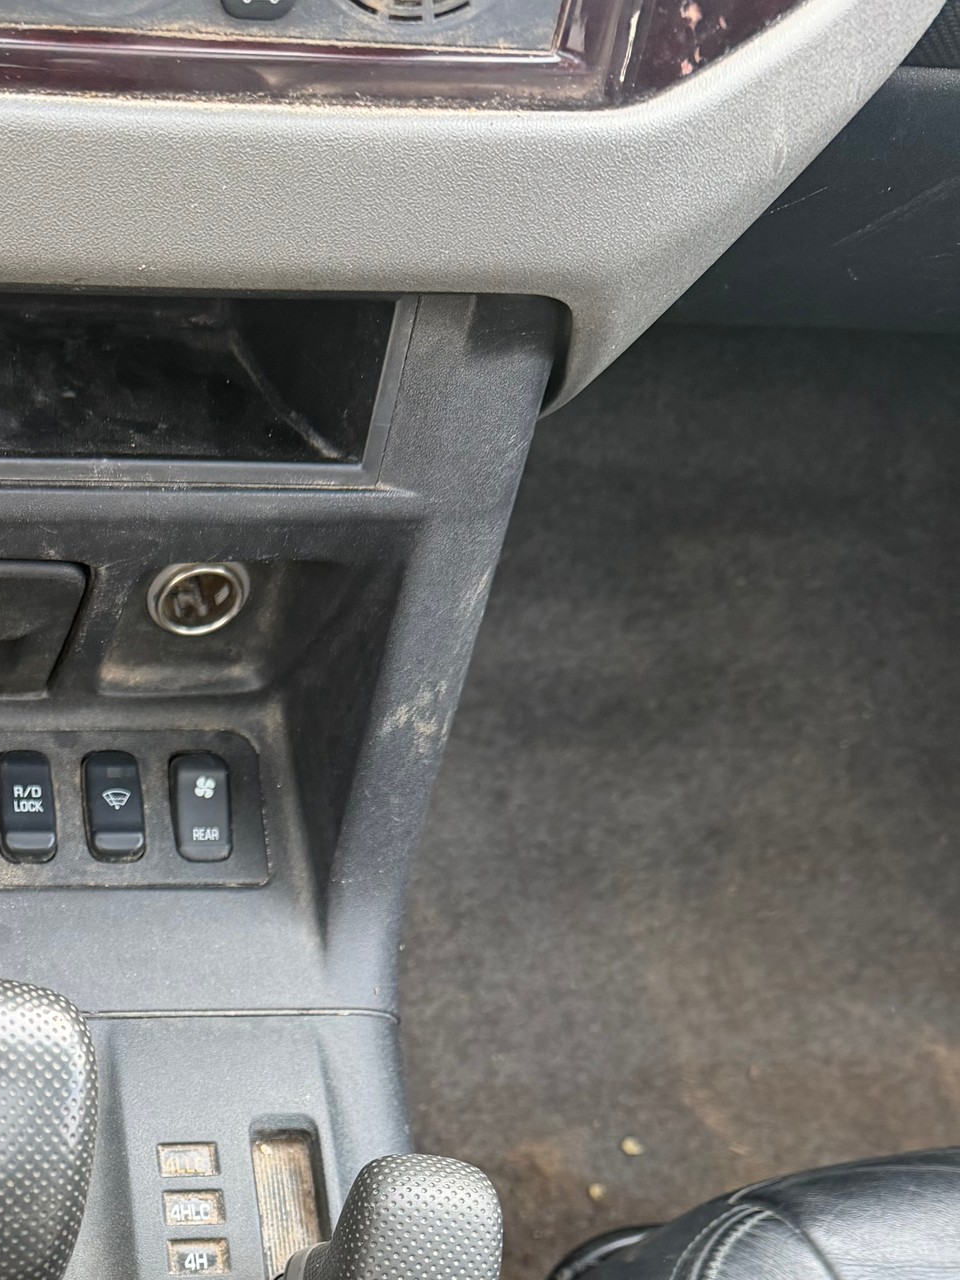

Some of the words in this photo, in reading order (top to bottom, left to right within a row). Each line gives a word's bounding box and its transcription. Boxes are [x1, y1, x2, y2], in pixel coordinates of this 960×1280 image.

[13, 784, 42, 798] R/D
[13, 799, 44, 813] LOCK
[192, 826, 220, 841] REAR
[184, 1252, 208, 1271] 4H
